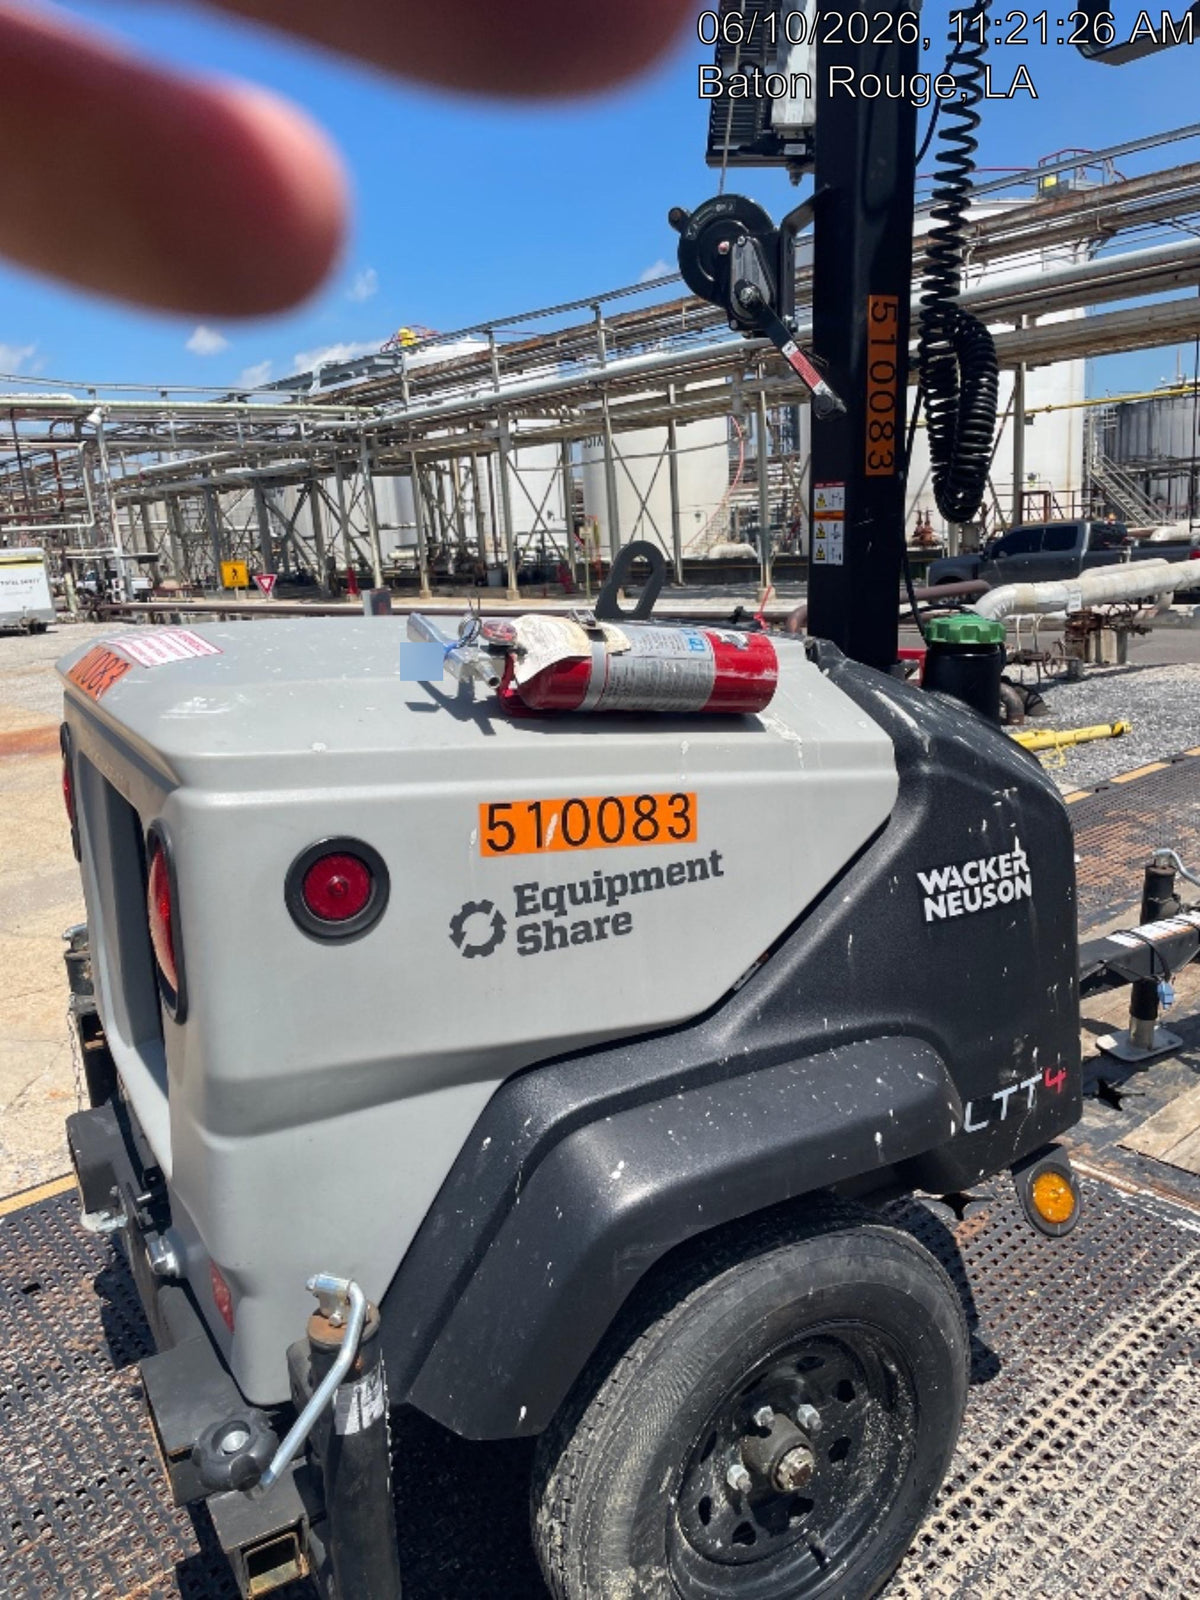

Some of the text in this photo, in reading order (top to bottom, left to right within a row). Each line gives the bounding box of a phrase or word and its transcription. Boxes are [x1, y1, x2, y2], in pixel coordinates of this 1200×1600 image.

[868, 301, 898, 470] 510083
[486, 793, 691, 852] 510083
[513, 849, 724, 917] Equipment
[917, 850, 1030, 896] WACKER
[924, 874, 1032, 922] NEUSON
[516, 911, 632, 957] Share
